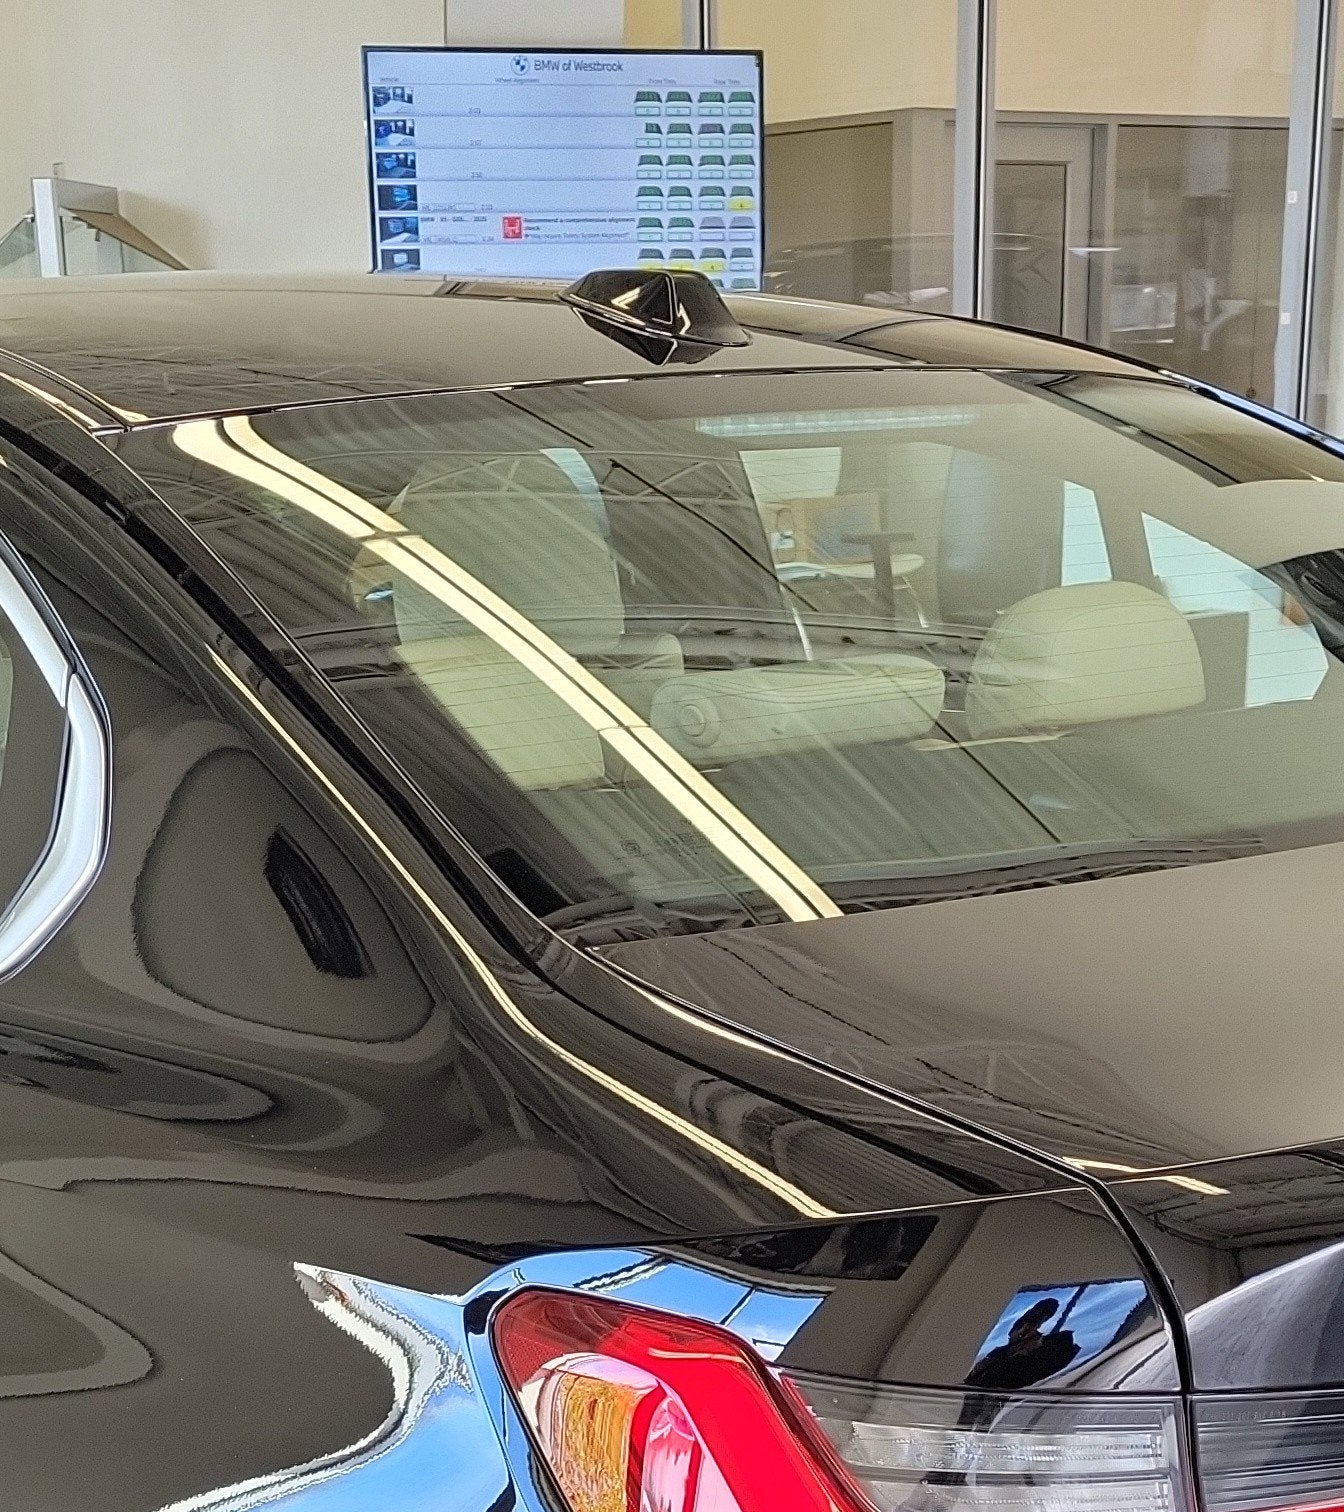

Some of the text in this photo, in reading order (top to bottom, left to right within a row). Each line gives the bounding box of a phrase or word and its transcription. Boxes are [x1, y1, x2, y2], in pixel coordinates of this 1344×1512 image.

[533, 59, 624, 71] BMW of Westbrook
